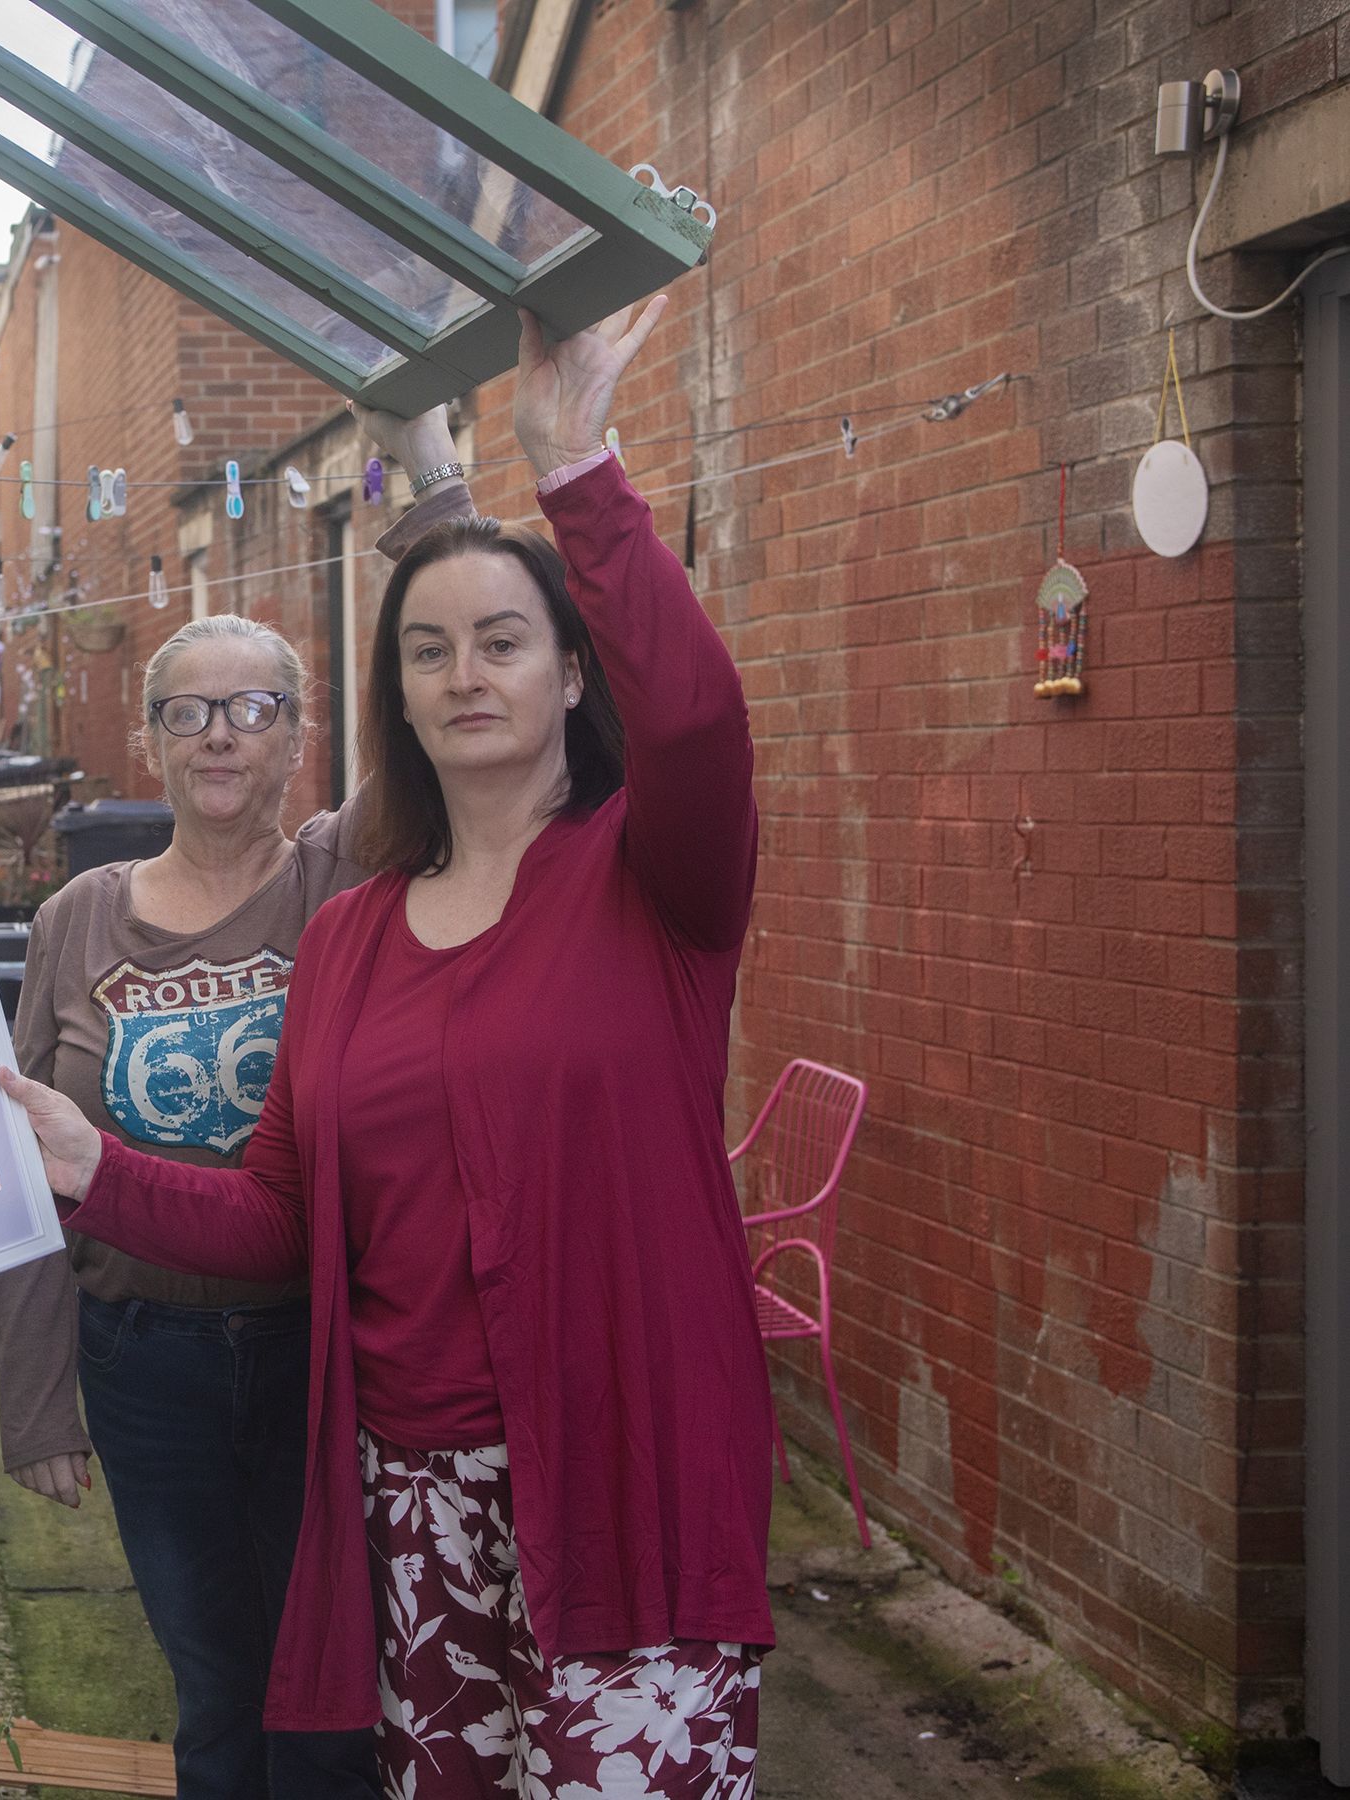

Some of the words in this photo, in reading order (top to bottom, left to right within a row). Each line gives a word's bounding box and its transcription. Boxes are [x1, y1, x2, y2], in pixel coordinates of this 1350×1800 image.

[124, 967, 278, 1011] ROUTE
[194, 1011, 219, 1026] US
[127, 1003, 278, 1129] 66
